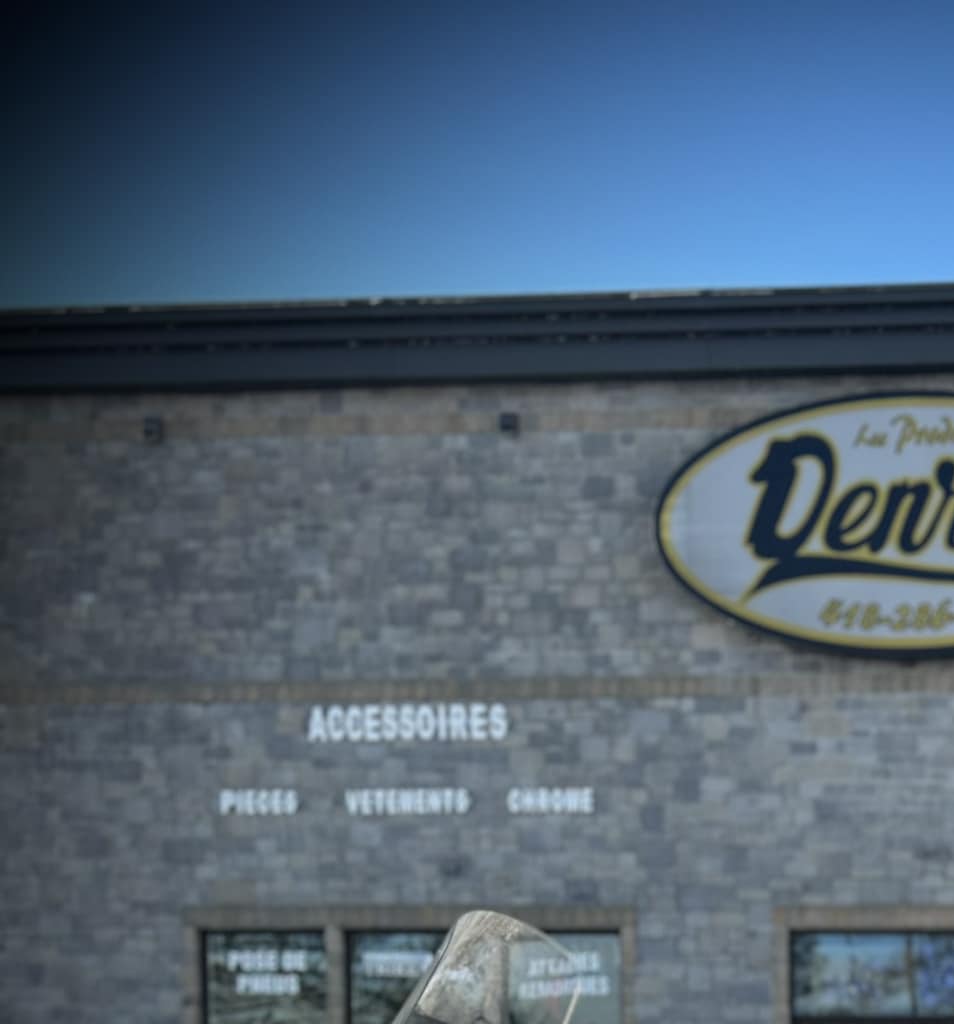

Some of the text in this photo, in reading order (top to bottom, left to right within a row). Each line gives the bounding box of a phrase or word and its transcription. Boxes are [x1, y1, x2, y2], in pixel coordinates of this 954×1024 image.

[307, 703, 507, 743] ACCESSOIRES
[218, 787, 595, 816] PIECES VETEMENTS CHROME
